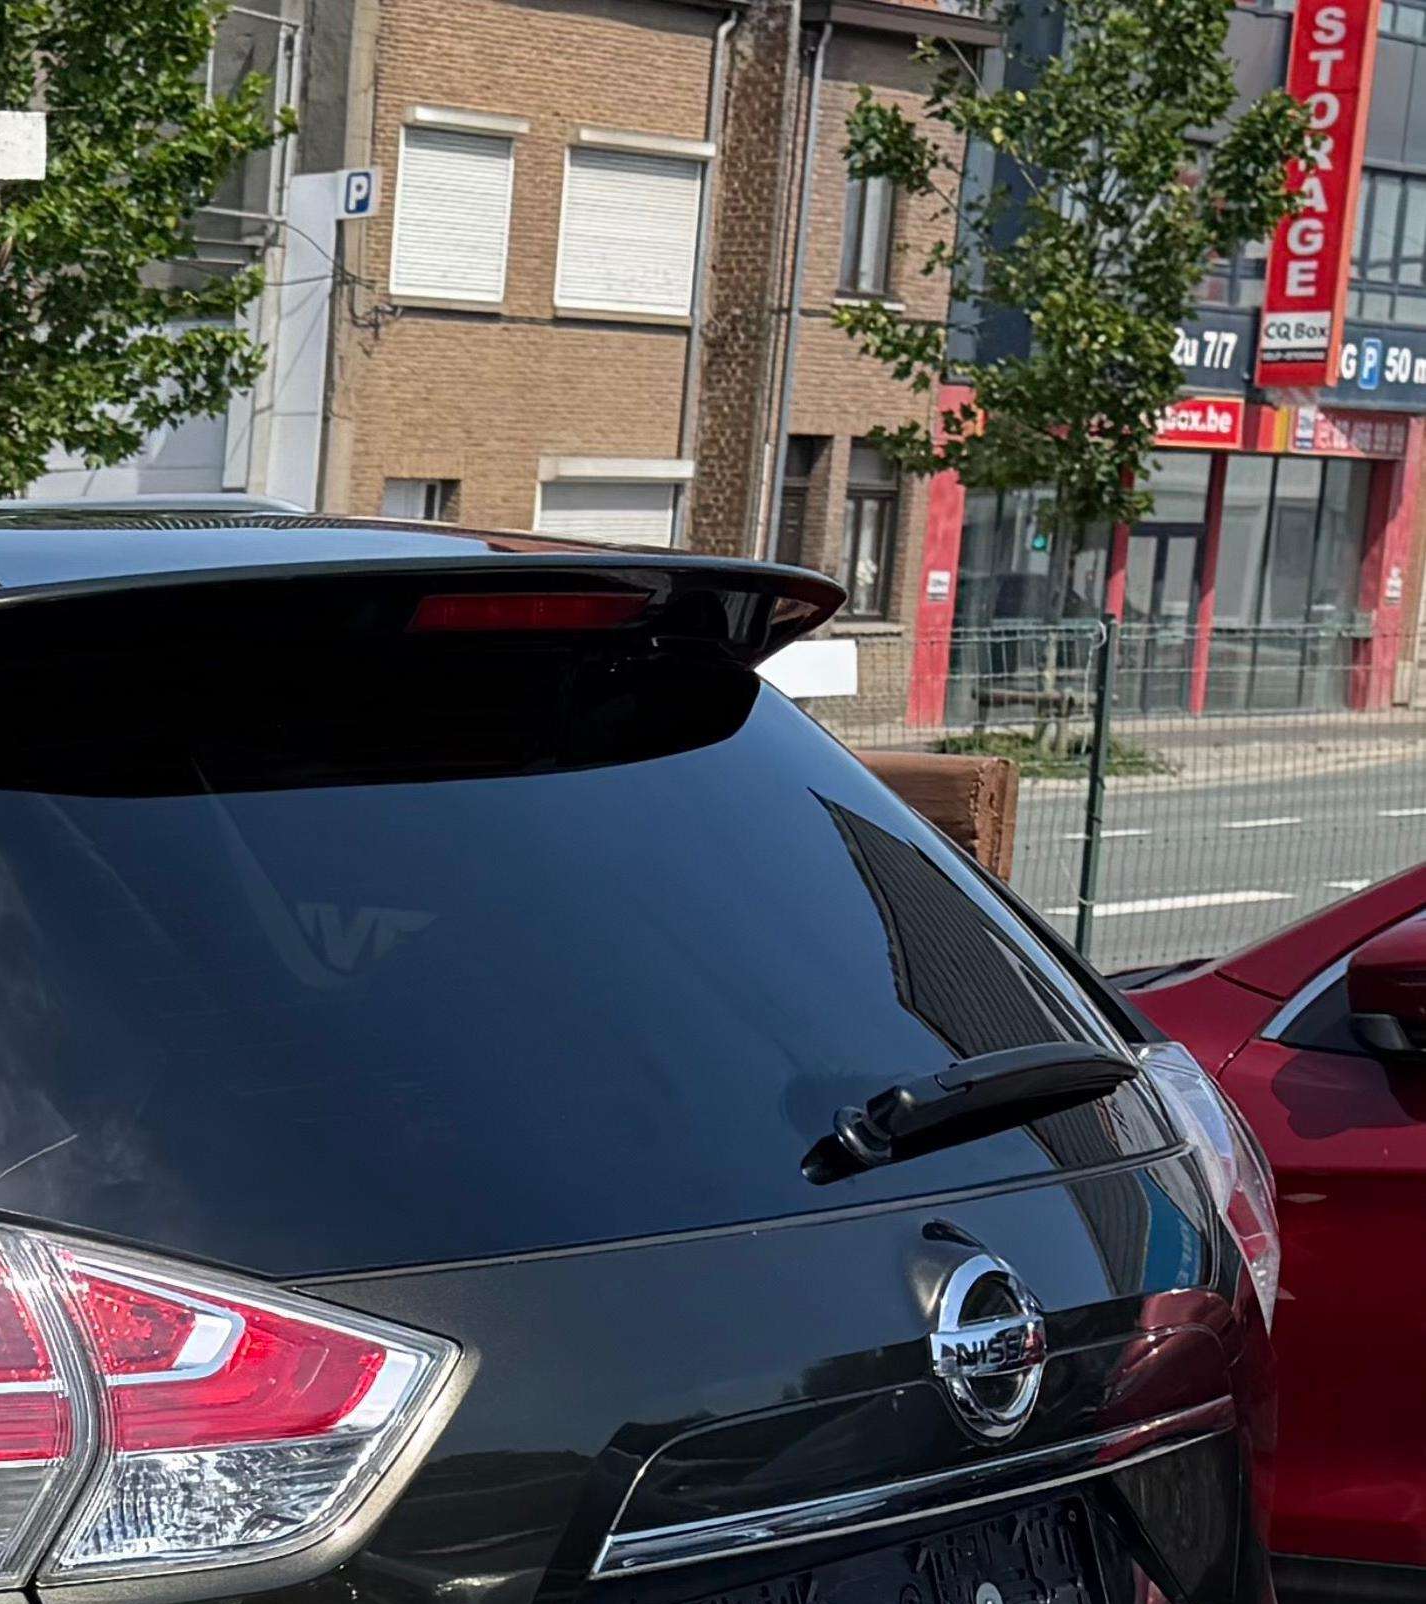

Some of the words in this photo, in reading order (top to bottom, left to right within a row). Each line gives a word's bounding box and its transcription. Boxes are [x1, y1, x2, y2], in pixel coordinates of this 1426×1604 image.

[1285, 6, 1347, 297] STORAGE
[349, 175, 368, 210] P
[1203, 330, 1238, 369] 7/7
[1264, 322, 1293, 341] CQ
[1295, 322, 1326, 339] Box
[1385, 347, 1412, 383] 50
